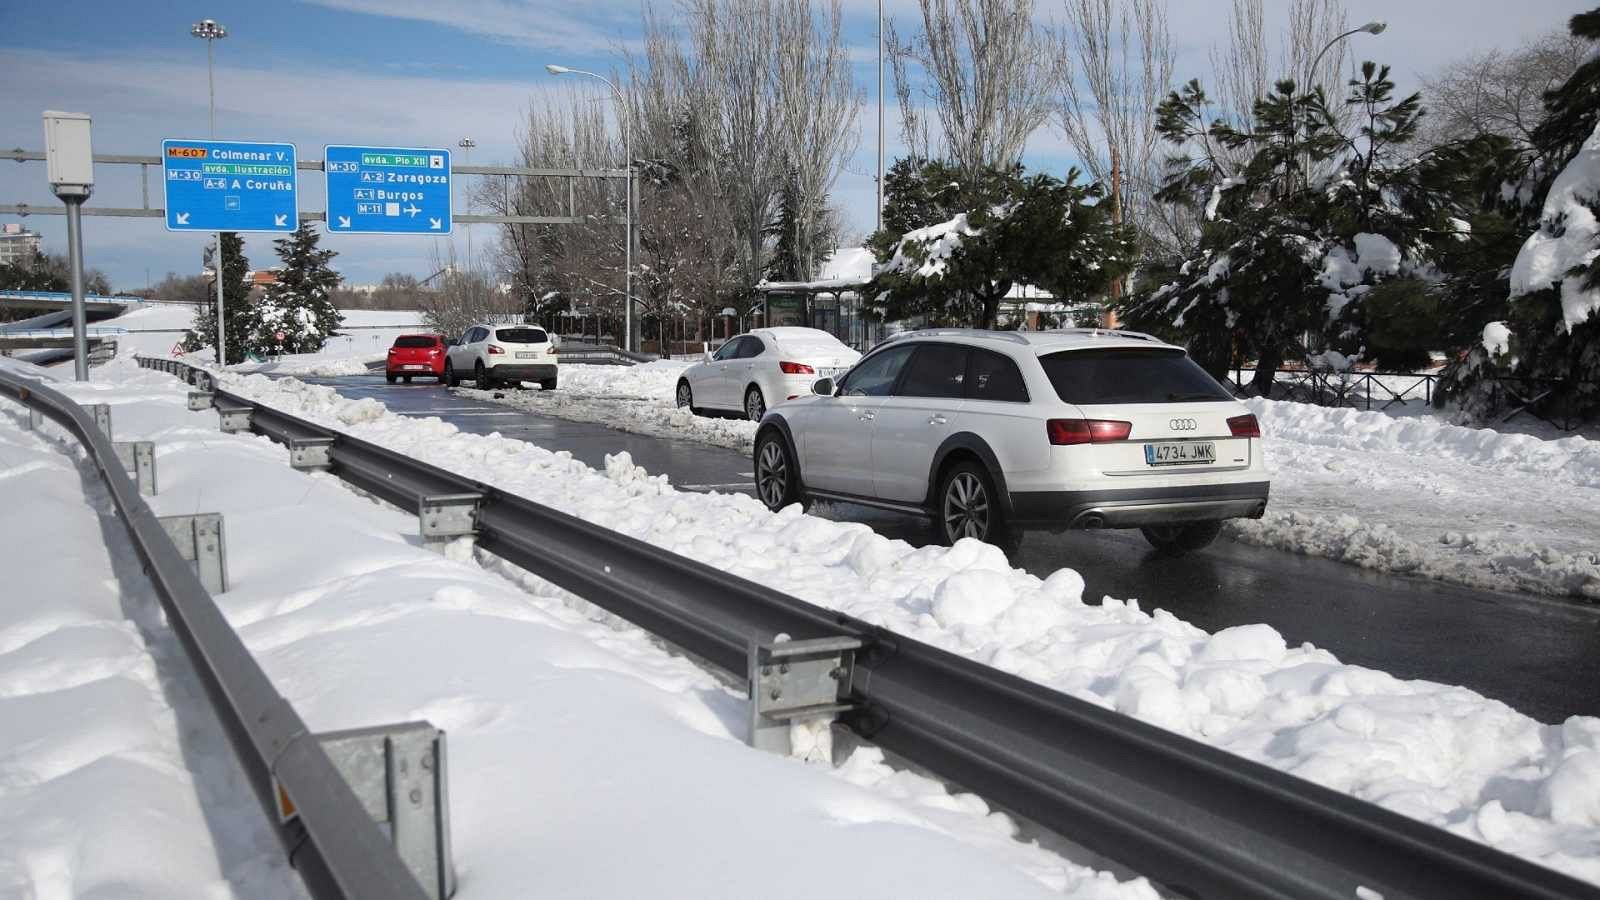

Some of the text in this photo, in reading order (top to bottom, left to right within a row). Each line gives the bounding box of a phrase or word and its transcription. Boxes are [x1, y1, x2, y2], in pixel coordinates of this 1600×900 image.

[168, 148, 289, 162] M-607 Colmenar V.
[364, 156, 390, 165] avda.
[413, 158, 425, 166] XII
[205, 165, 289, 175] avda. Ilustración
[329, 163, 357, 171] M-30
[363, 172, 447, 185] A-2 Zaragoza
[206, 179, 292, 191] A-6 A Coruña
[356, 190, 424, 201] A-1 Burgos
[359, 204, 381, 213] M-11
[1156, 444, 1213, 460] 4734 JMK
